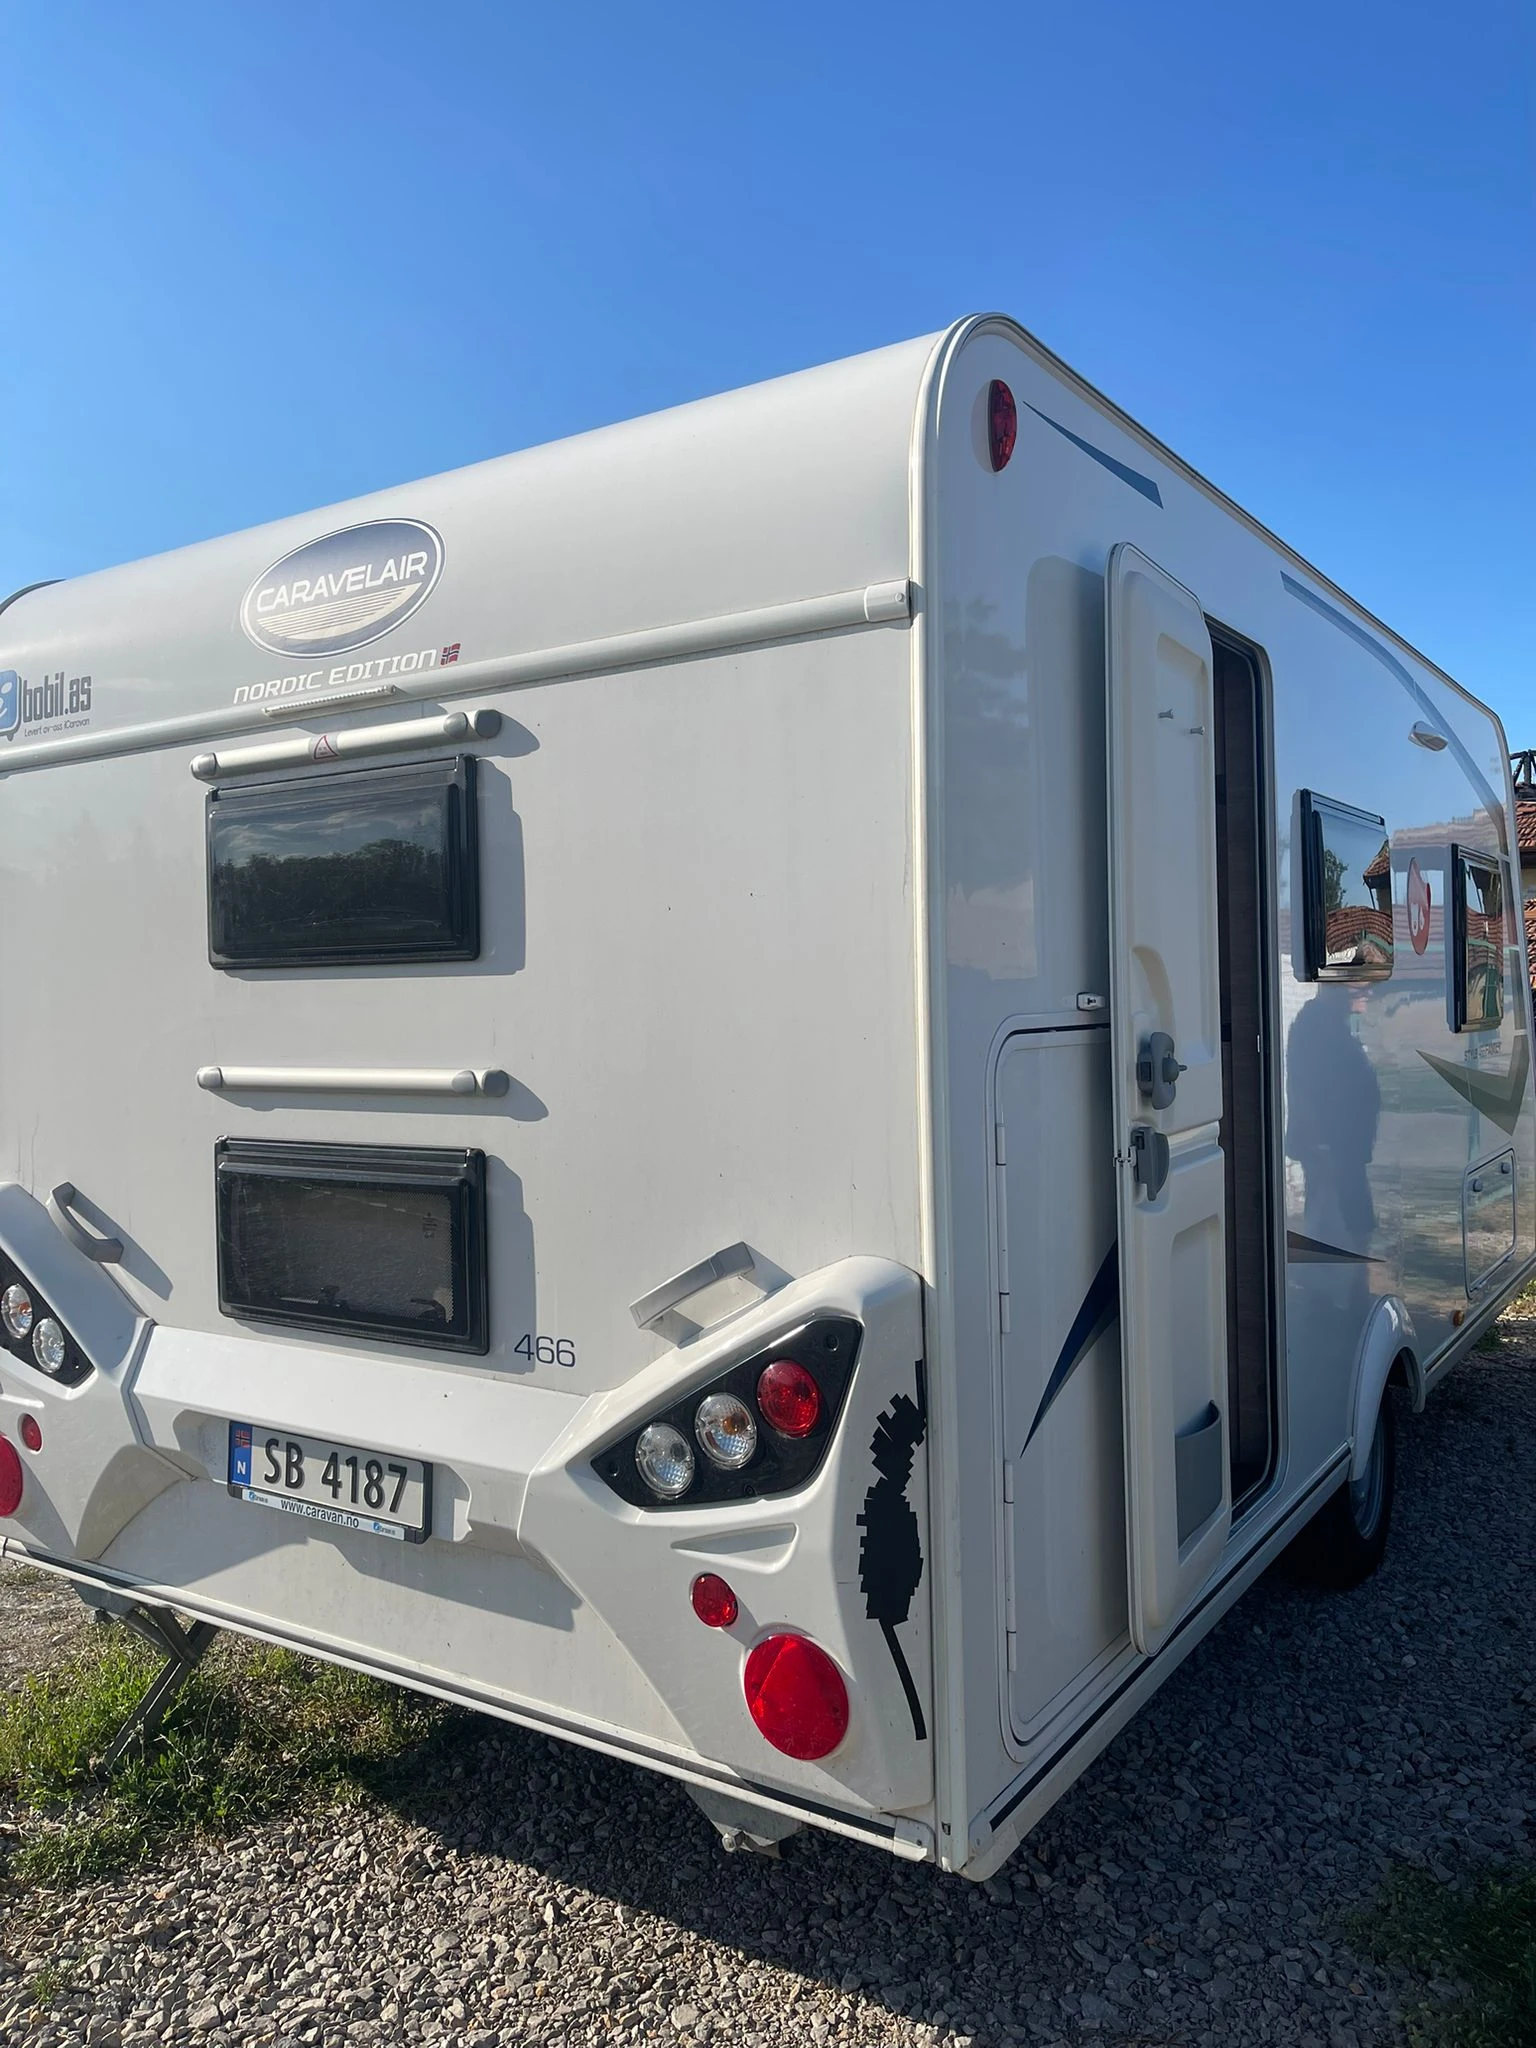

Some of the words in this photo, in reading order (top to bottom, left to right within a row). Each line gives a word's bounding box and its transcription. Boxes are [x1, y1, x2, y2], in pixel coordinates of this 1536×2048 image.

[257, 551, 428, 613] CARAVELAIR
[233, 670, 324, 704] NORDIC
[328, 649, 438, 685] EDITION
[24, 725, 42, 738] Levert
[514, 1333, 576, 1368] 466
[237, 1460, 247, 1475] N
[264, 1438, 304, 1490] SB
[321, 1451, 408, 1514] 4187
[280, 1498, 360, 1529] www.caravan.no
